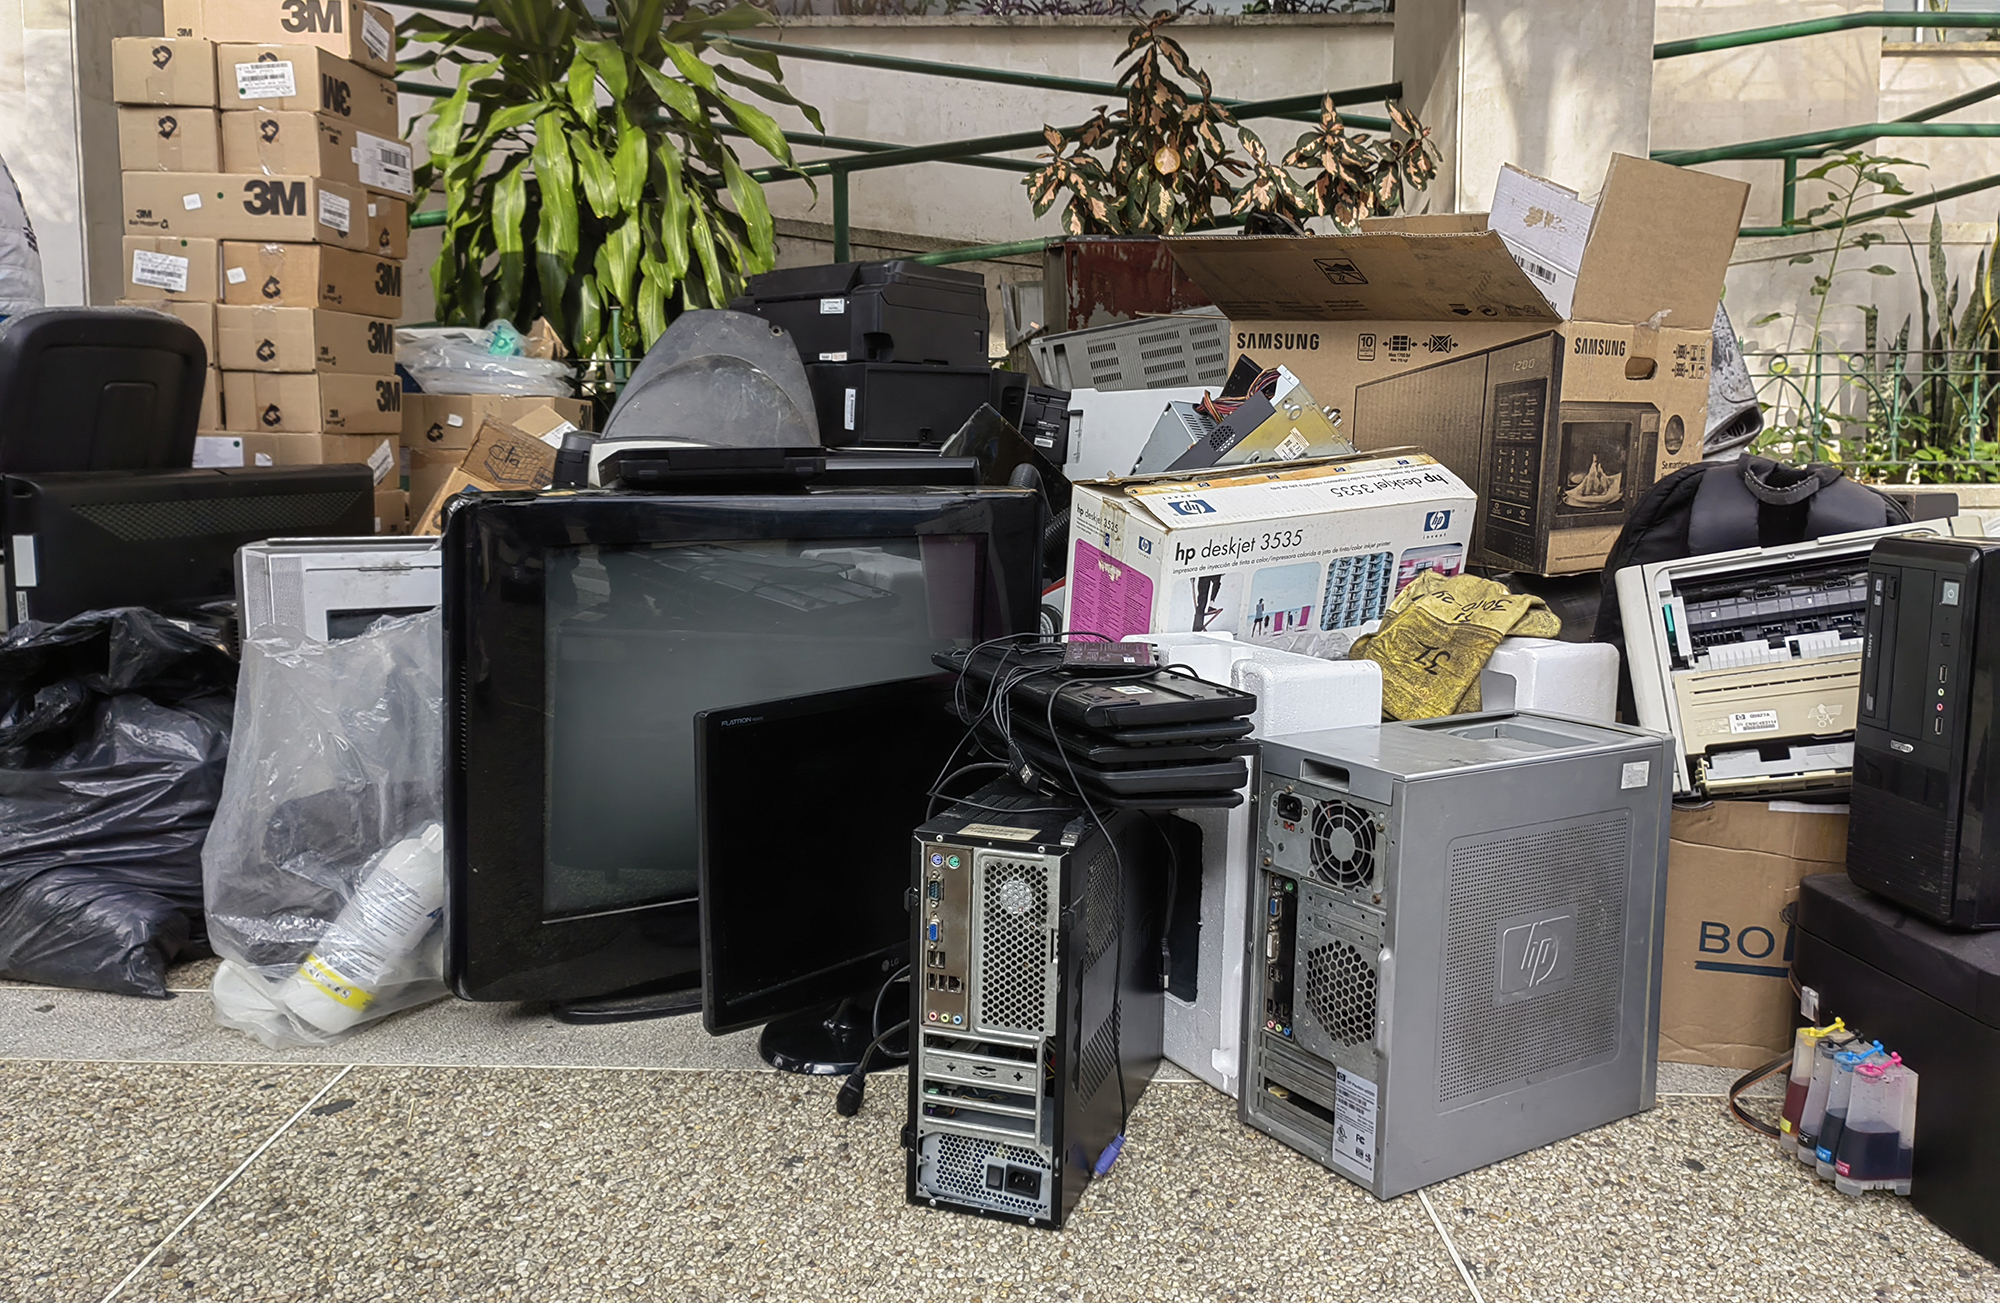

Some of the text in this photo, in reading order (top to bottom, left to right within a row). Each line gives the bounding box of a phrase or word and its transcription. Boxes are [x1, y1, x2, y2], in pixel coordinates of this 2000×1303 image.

[281, 0, 343, 34] 3M
[177, 28, 193, 38] 3M
[322, 72, 351, 118] 3M
[243, 180, 307, 217] 3M
[136, 209, 152, 219] 3M
[375, 262, 401, 298] 3M
[367, 321, 394, 355] 3M
[1236, 332, 1320, 351] SAMSUNG
[1361, 336, 1374, 348] 10
[1574, 337, 1627, 357] SAMSUNG
[1512, 358, 1536, 372] 1200
[376, 380, 401, 413] 3M
[1330, 472, 1449, 498] hp deskjet 3535
[1084, 507, 1102, 526] deskje
[1103, 518, 1119, 534] 3535
[1174, 529, 1304, 566] hp deskjet 3535
[1172, 565, 1198, 575] impresora
[1231, 559, 1239, 567] de
[1866, 632, 1874, 658] SONY
[721, 716, 752, 727] FLATRON
[890, 957, 900, 967] LG
